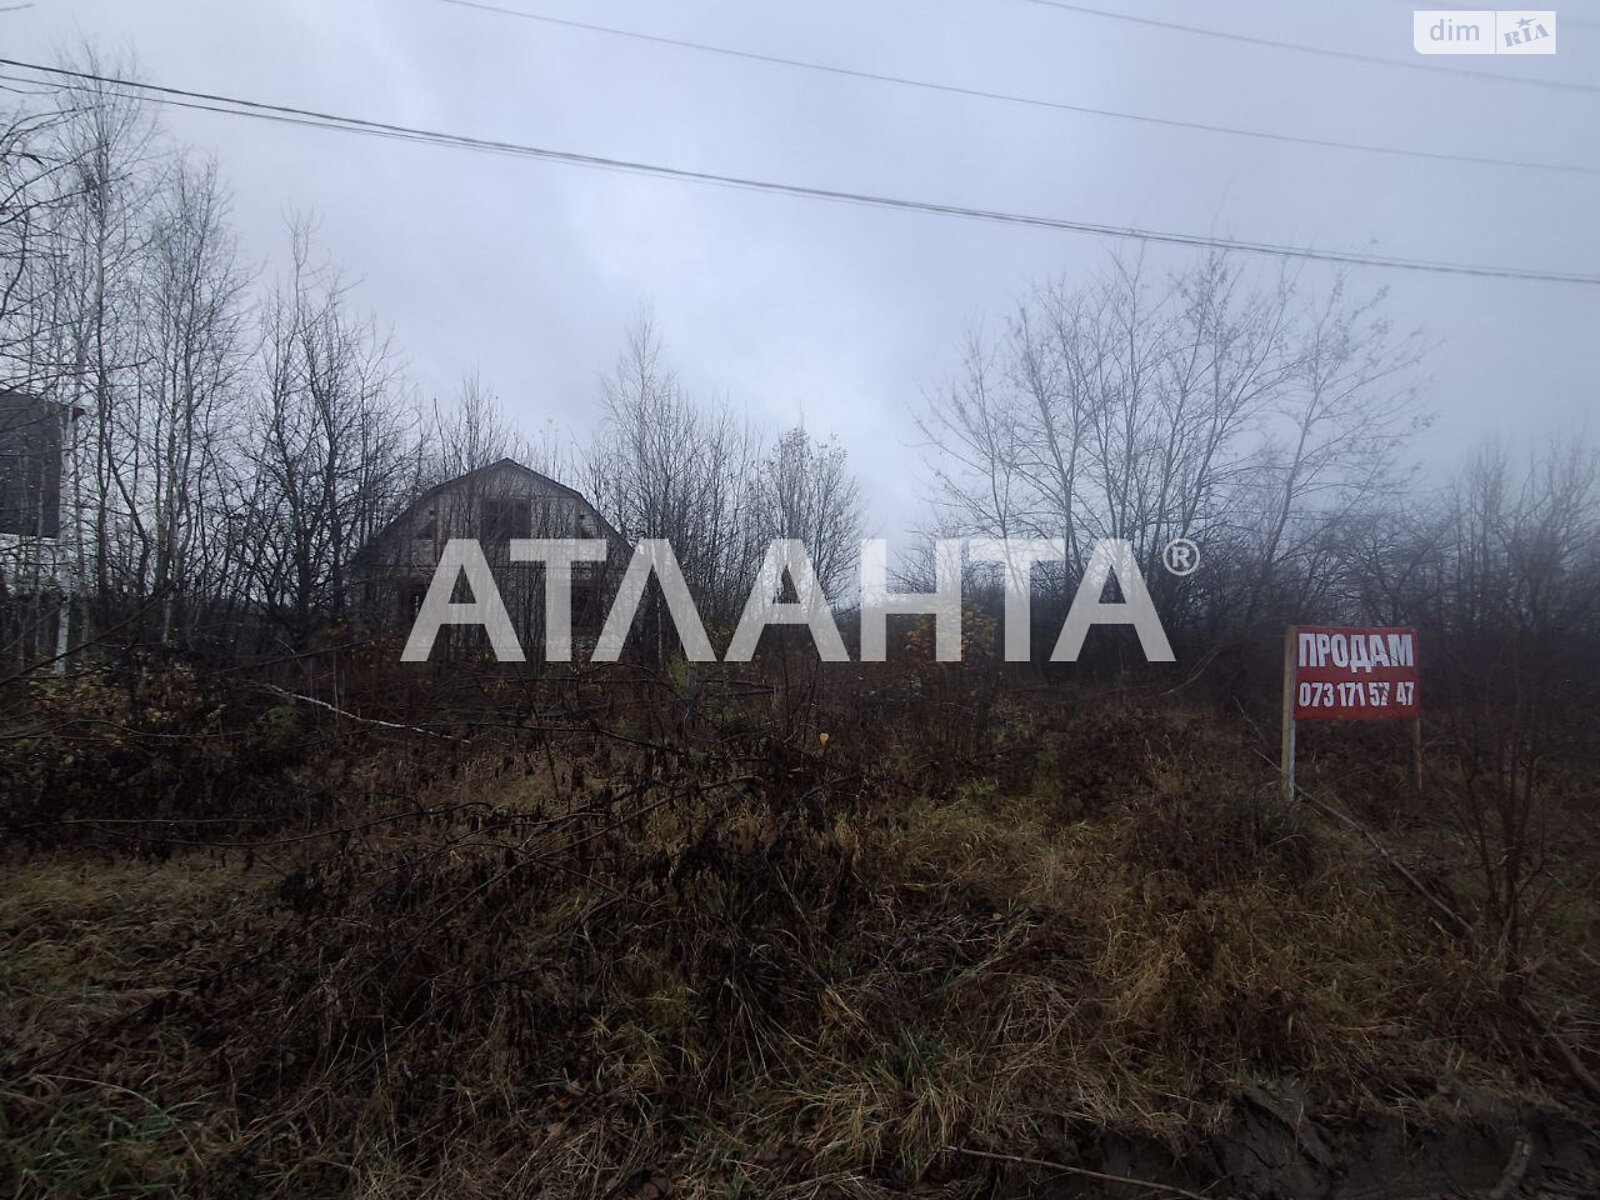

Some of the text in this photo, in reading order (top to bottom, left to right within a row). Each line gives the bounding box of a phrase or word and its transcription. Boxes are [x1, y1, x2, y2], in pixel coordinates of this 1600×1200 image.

[1298, 633, 1414, 673] ПРОДАМ
[1299, 682, 1334, 707] 073
[1337, 682, 1366, 707] 171
[1396, 681, 1415, 706] 47
